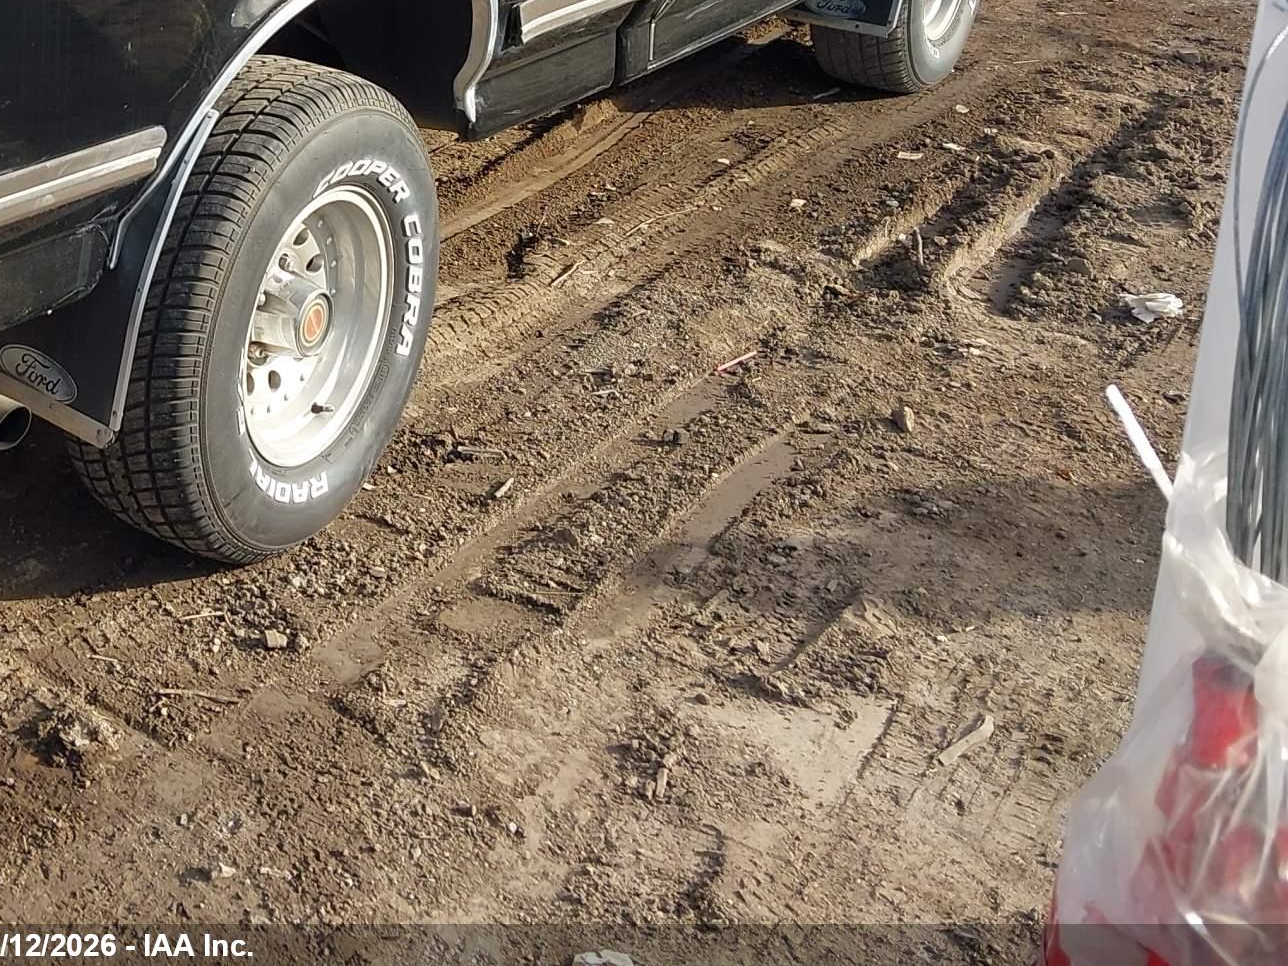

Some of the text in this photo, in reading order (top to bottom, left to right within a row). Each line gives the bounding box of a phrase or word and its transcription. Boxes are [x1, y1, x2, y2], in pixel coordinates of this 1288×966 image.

[312, 159, 411, 204] COOPER
[396, 214, 423, 356] COBRA
[15, 353, 62, 395] Ford
